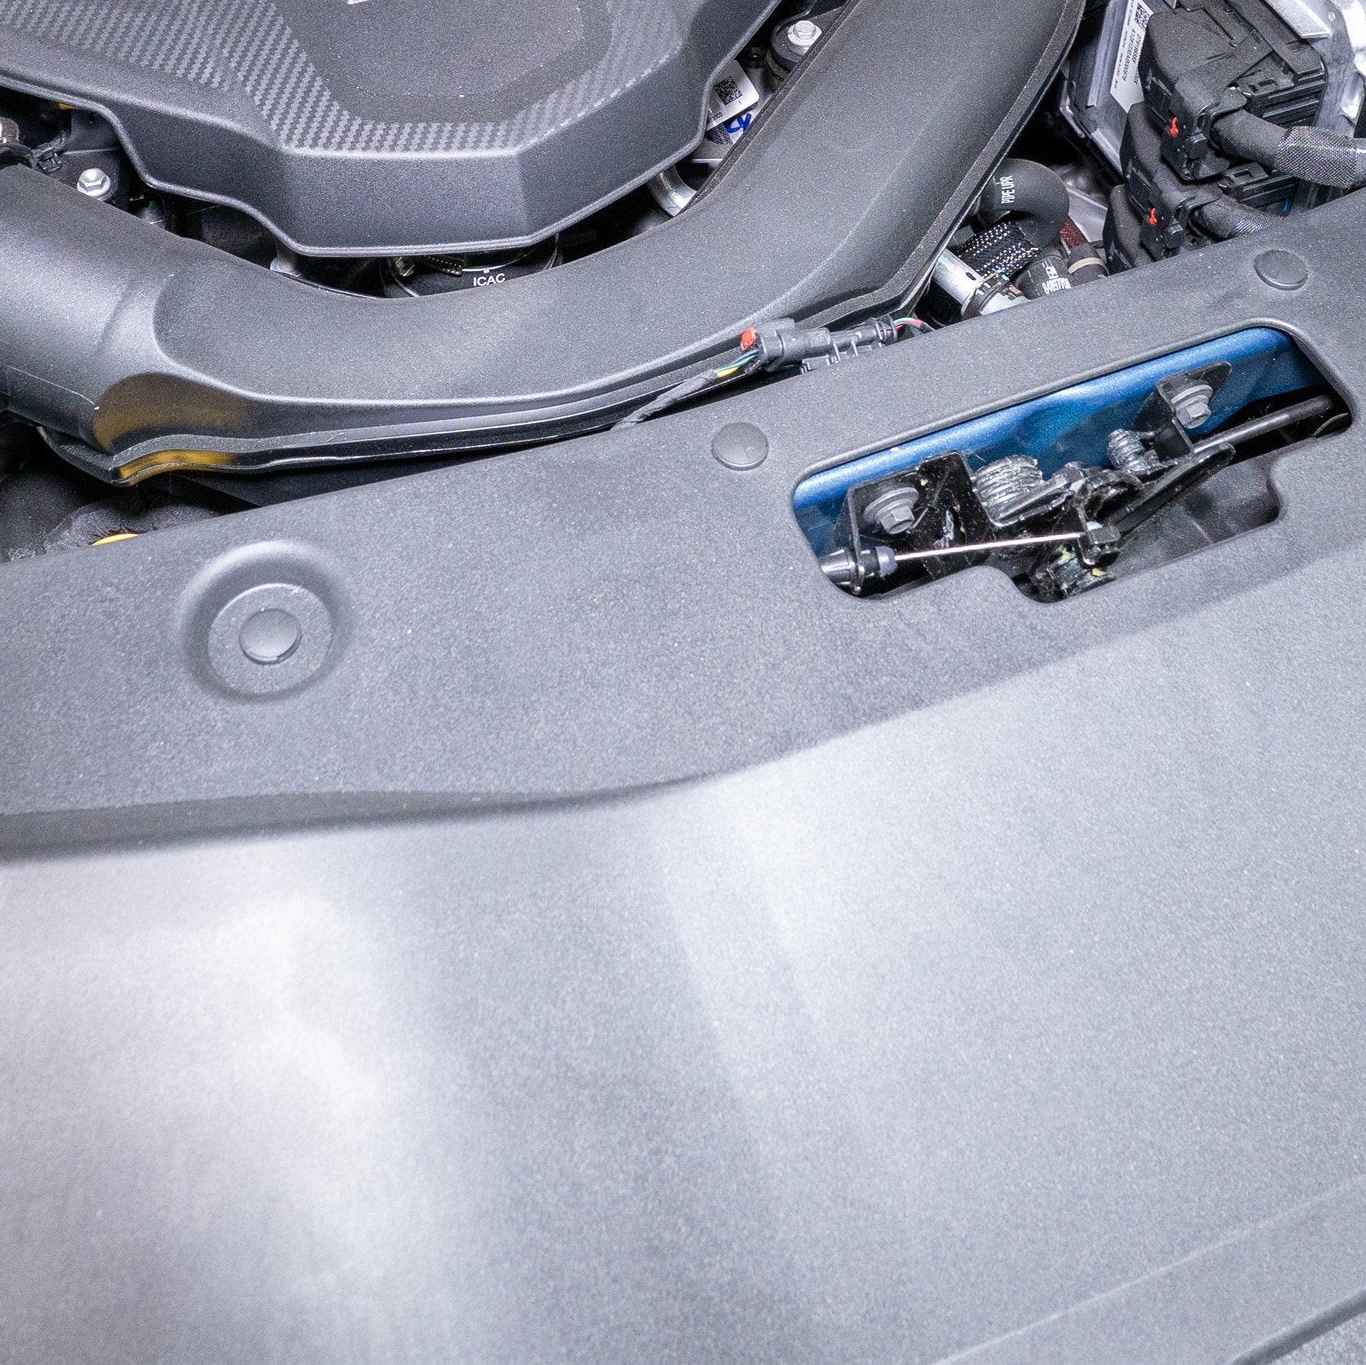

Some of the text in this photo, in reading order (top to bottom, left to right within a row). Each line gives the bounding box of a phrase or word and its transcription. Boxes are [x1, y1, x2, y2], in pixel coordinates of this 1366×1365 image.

[1000, 175, 1015, 204] PIPE UPR
[473, 273, 505, 286] ICAC
